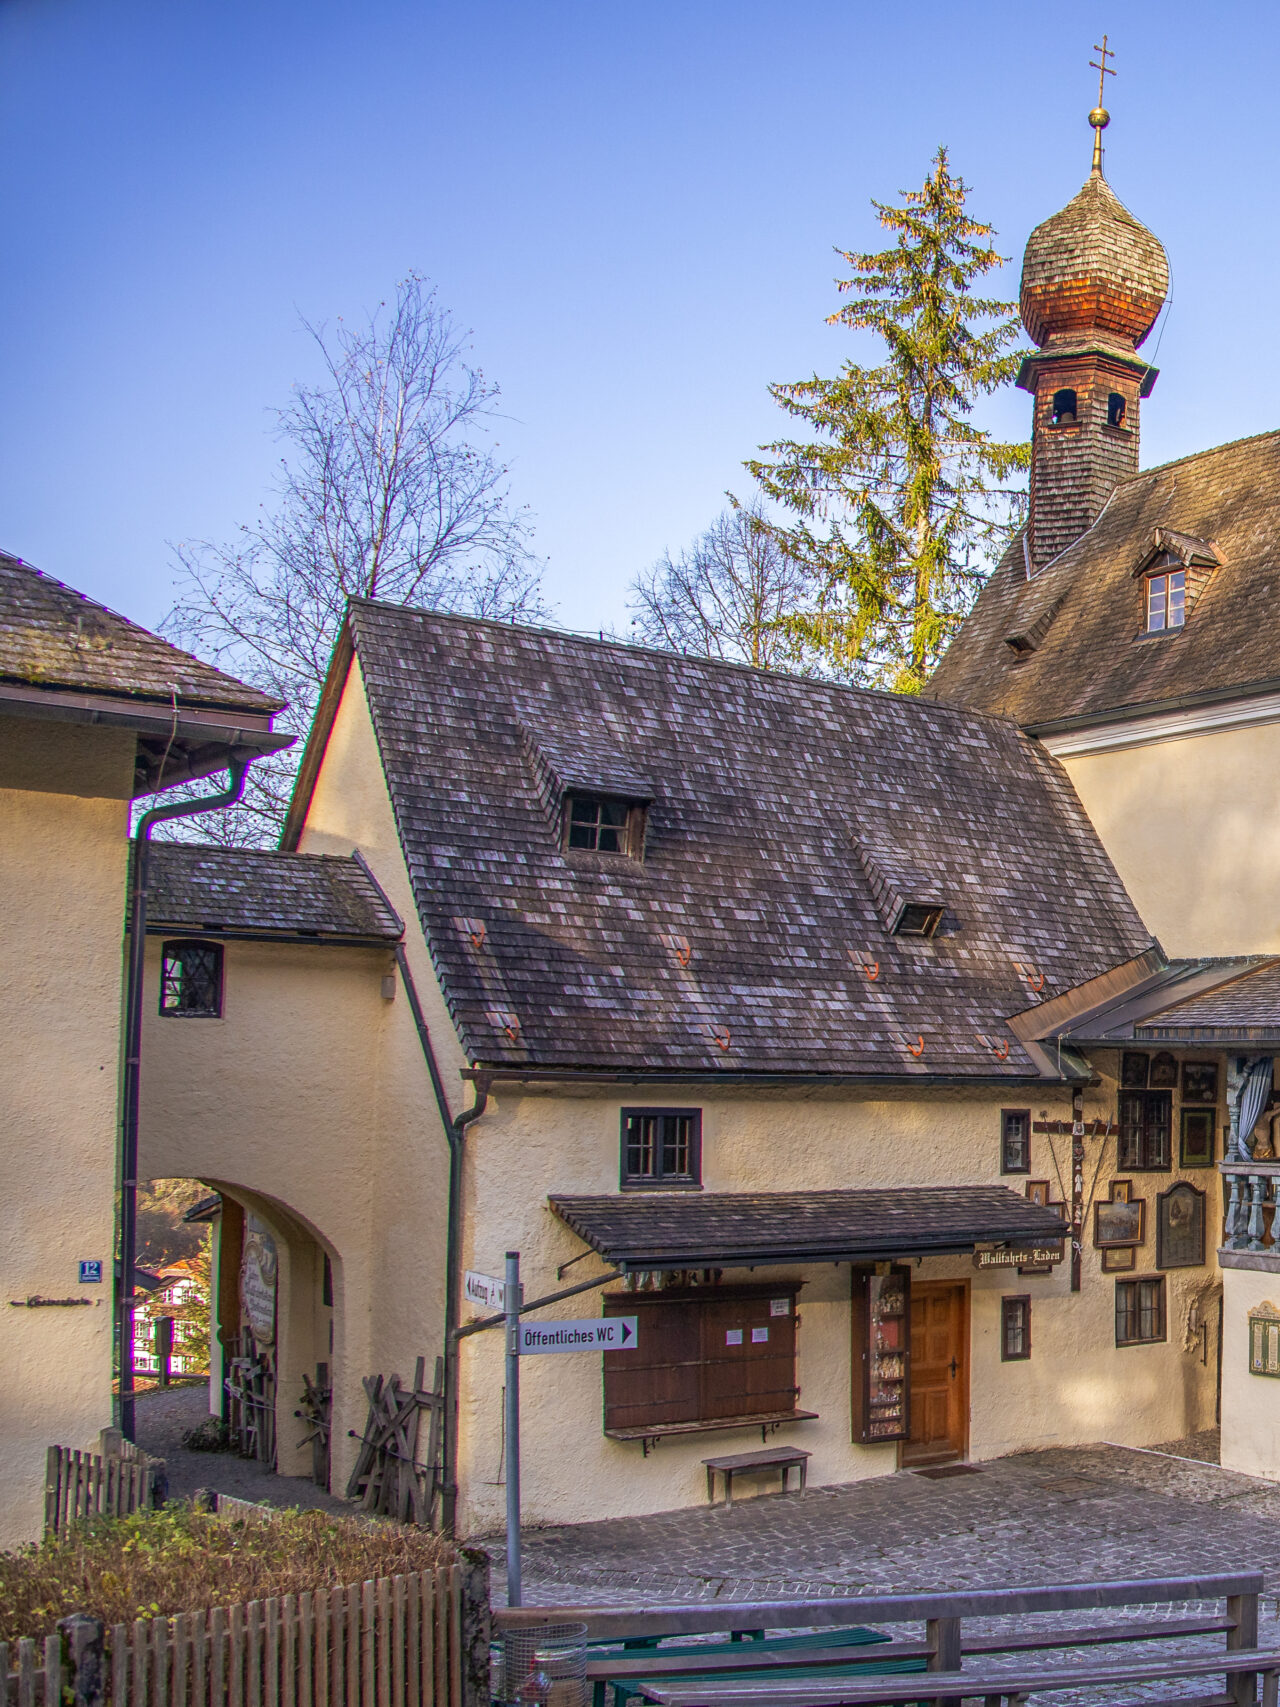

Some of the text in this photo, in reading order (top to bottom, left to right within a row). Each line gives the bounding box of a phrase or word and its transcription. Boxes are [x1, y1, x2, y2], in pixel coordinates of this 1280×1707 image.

[83, 1262, 98, 1275] 12
[471, 1278, 488, 1305] Aufzug
[524, 1326, 614, 1347] Öffentliches WC
